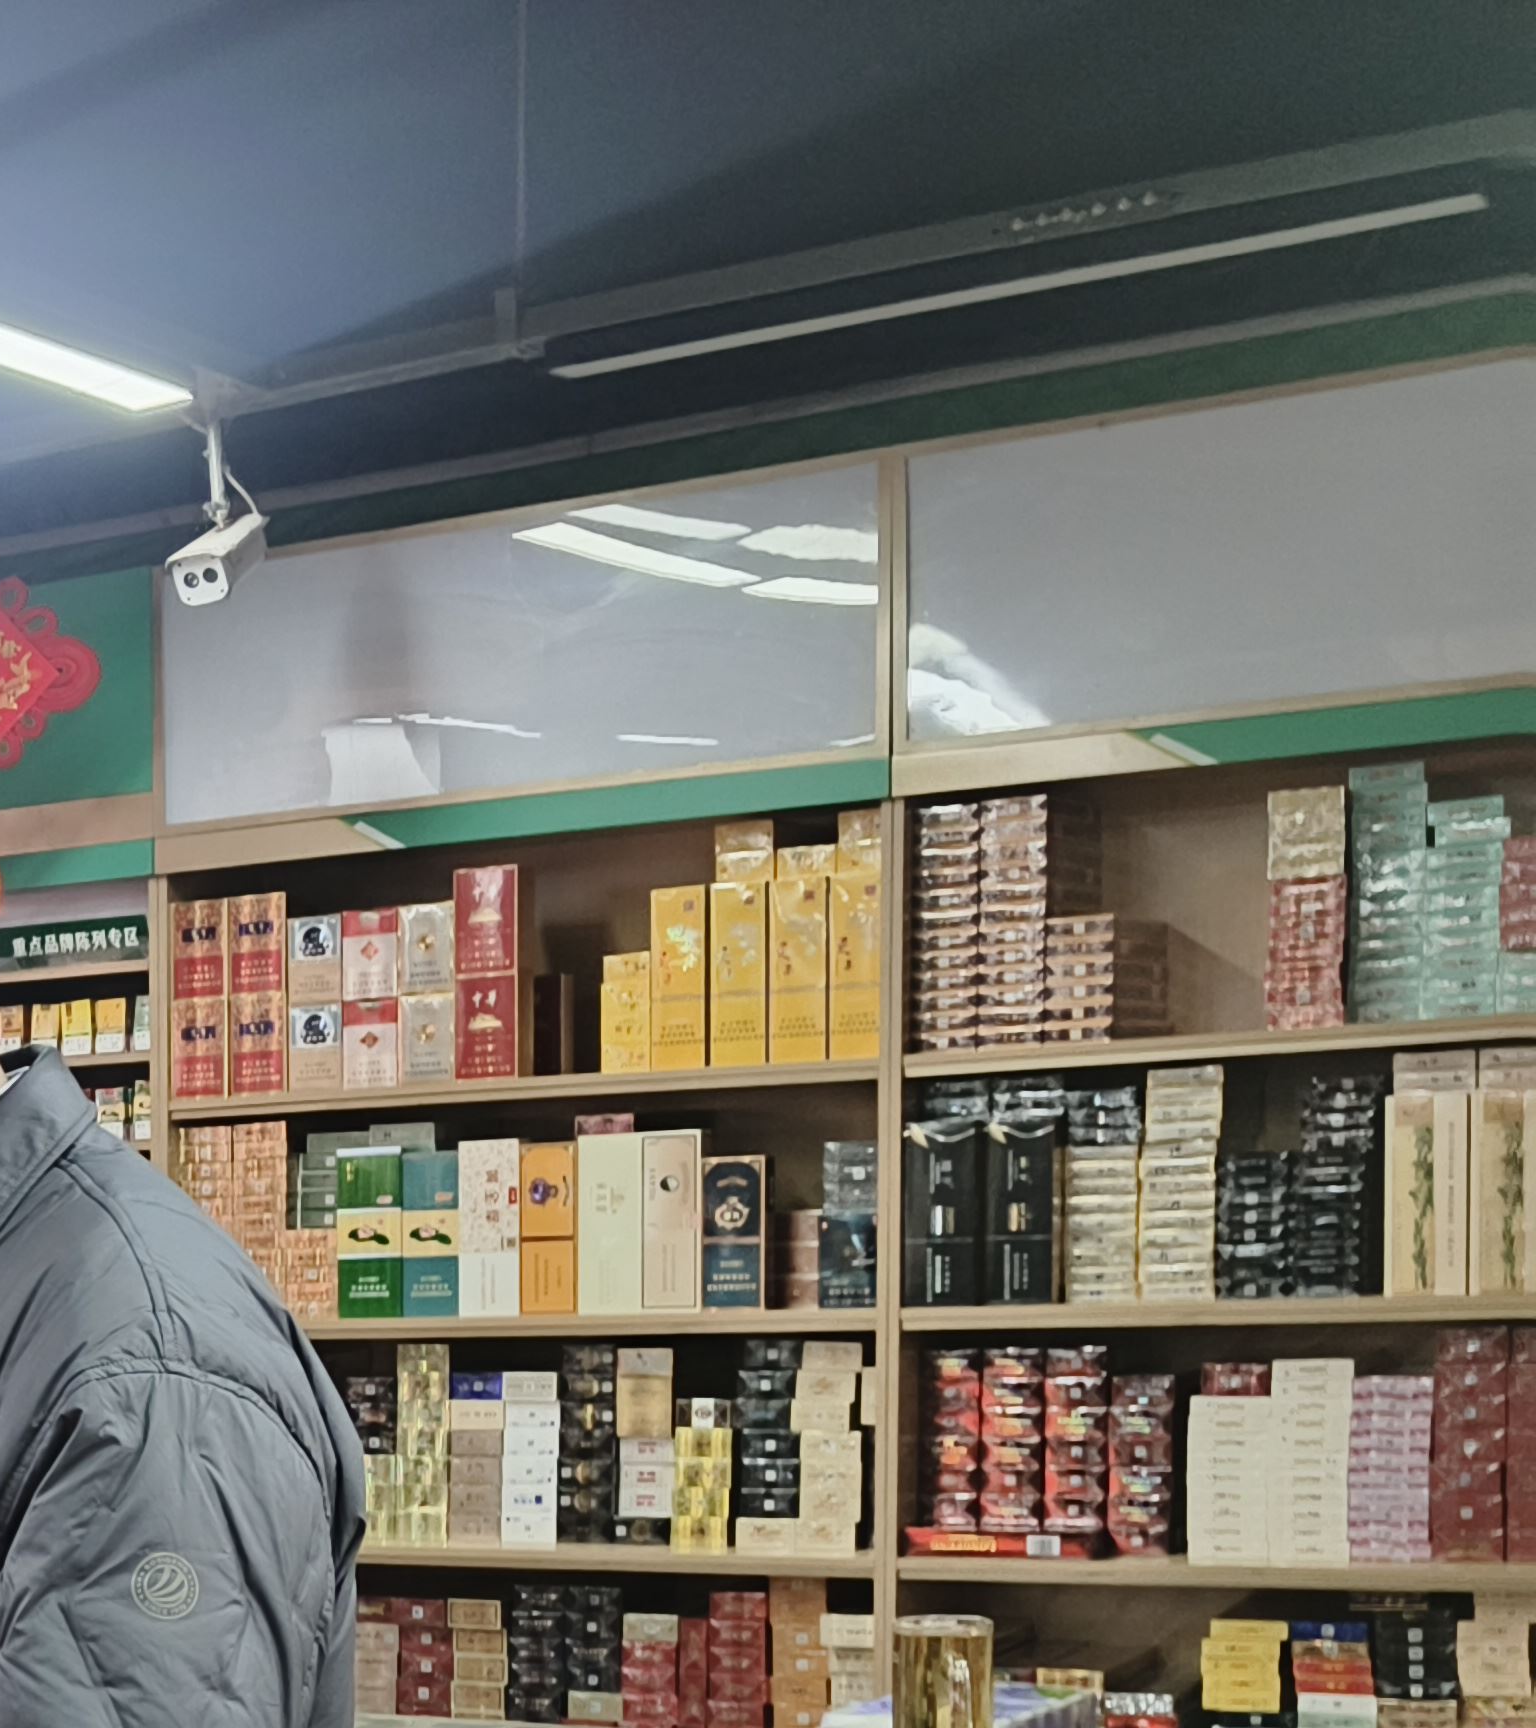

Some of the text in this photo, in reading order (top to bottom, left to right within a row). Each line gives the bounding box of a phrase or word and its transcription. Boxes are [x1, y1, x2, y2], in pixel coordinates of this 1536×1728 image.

[12, 926, 140, 958] 重点品牌陈列专区
